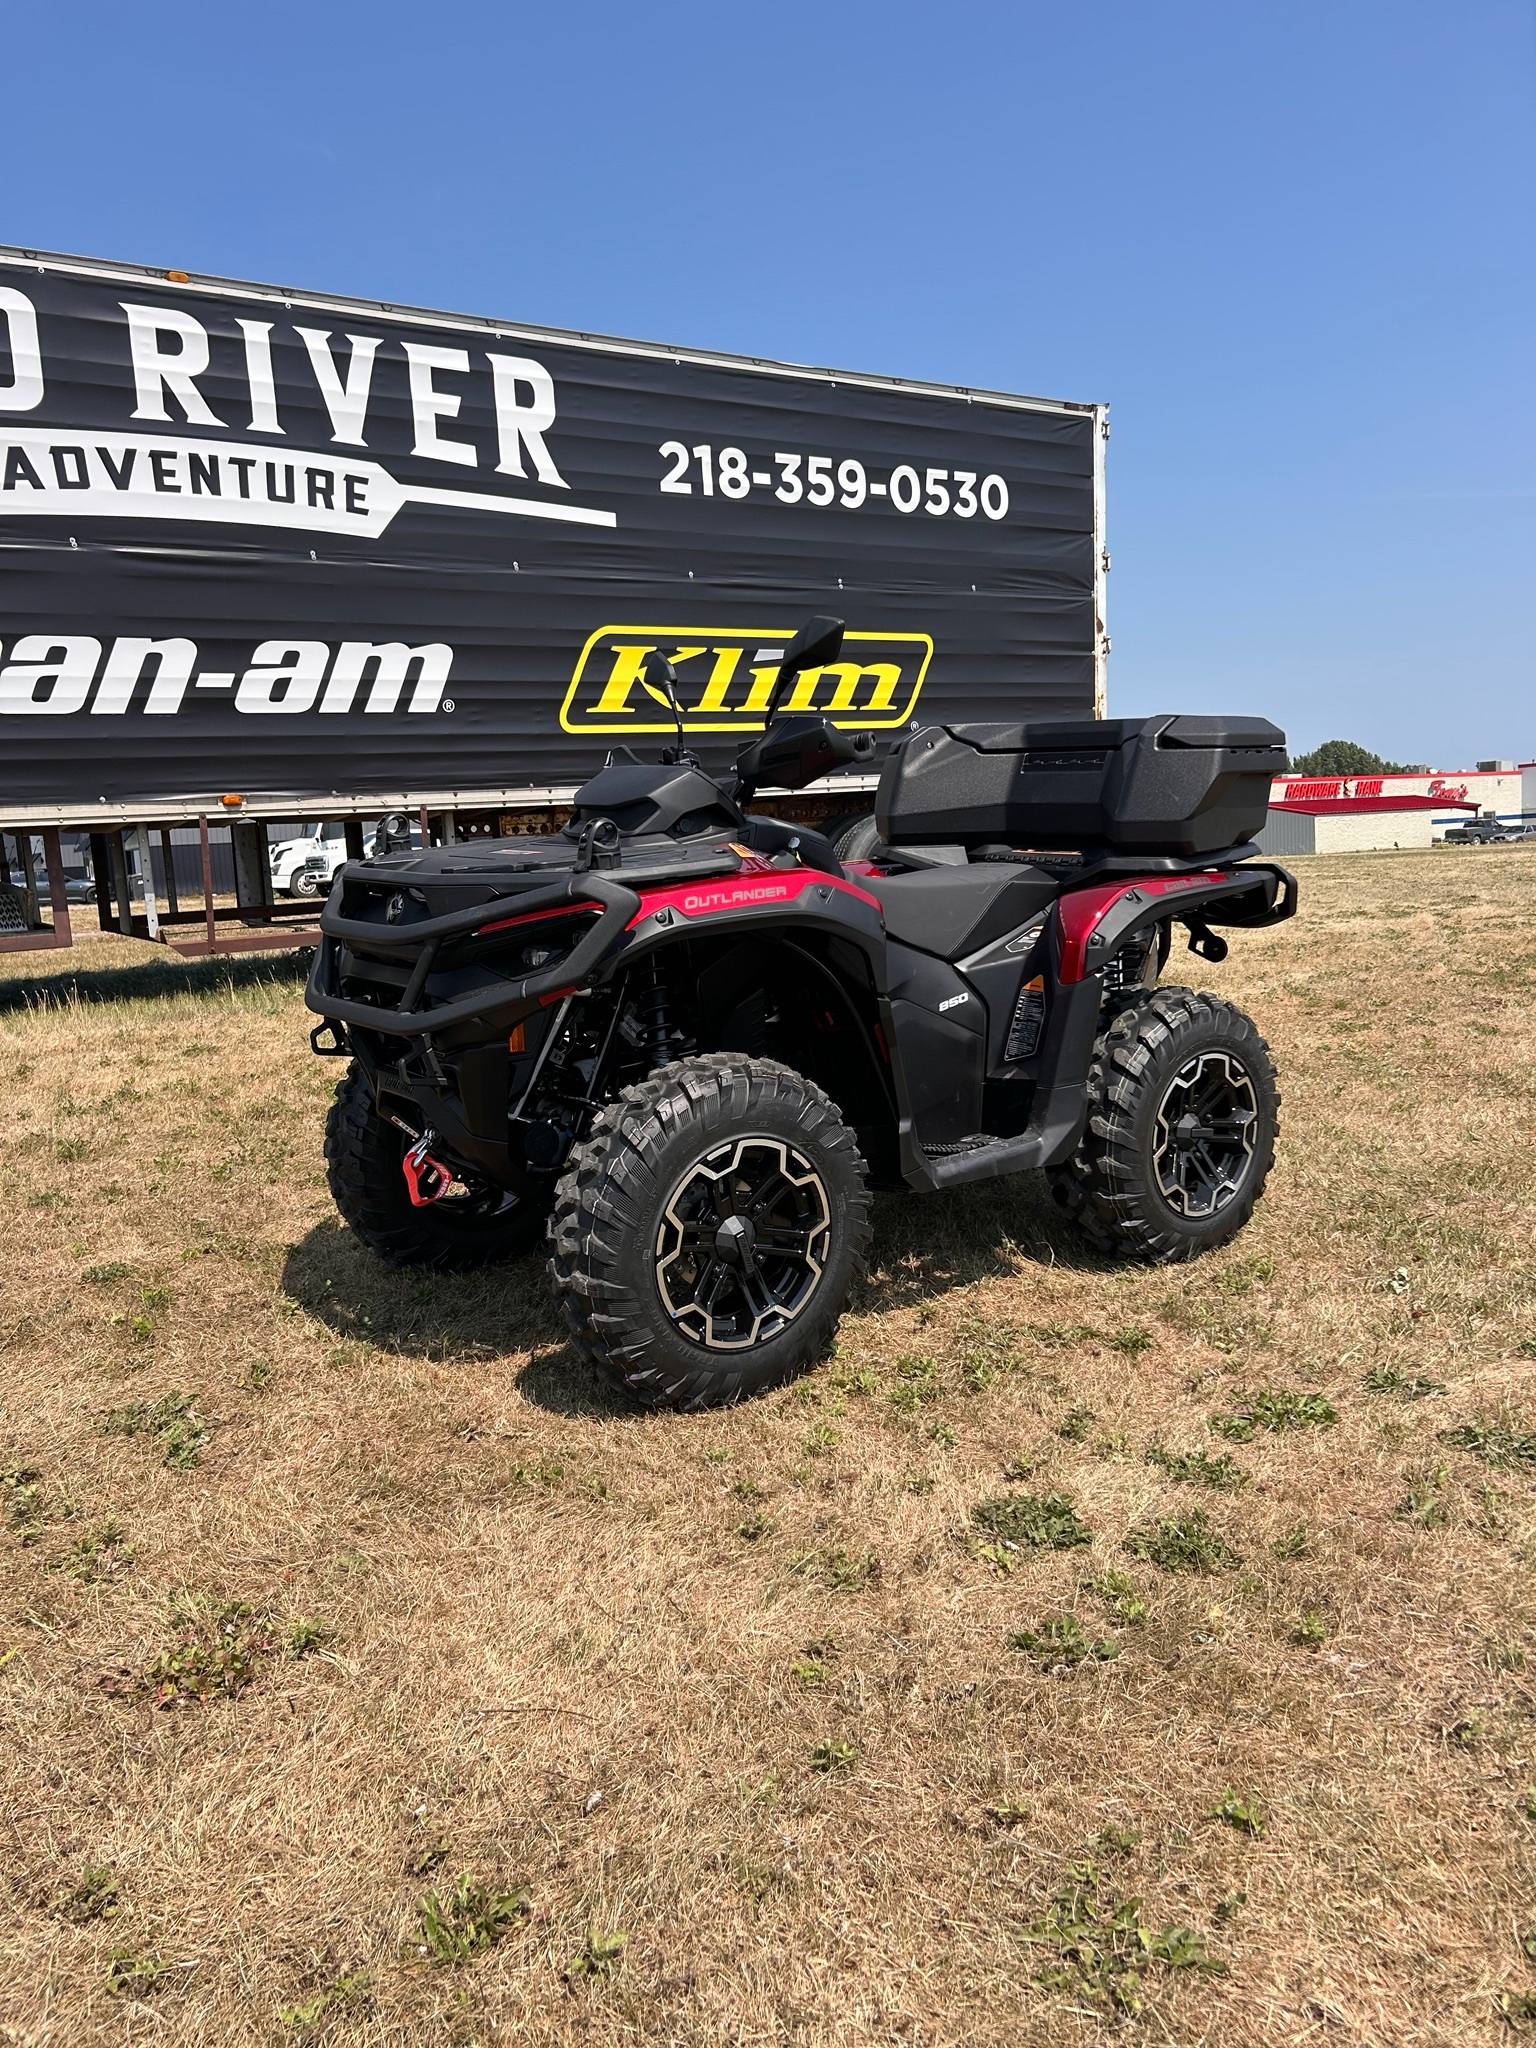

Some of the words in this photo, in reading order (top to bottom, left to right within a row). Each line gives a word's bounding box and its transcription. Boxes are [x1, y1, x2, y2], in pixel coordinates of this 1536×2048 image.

[117, 301, 571, 489] RIVER
[3, 445, 370, 516] ADVENTURE
[658, 440, 1009, 521] 218-359-0530
[0, 634, 455, 715] an-am
[586, 645, 903, 713] Klim
[1285, 782, 1341, 798] HARDWARE
[685, 886, 787, 910] OUTLANDER
[939, 992, 969, 1012] 850
